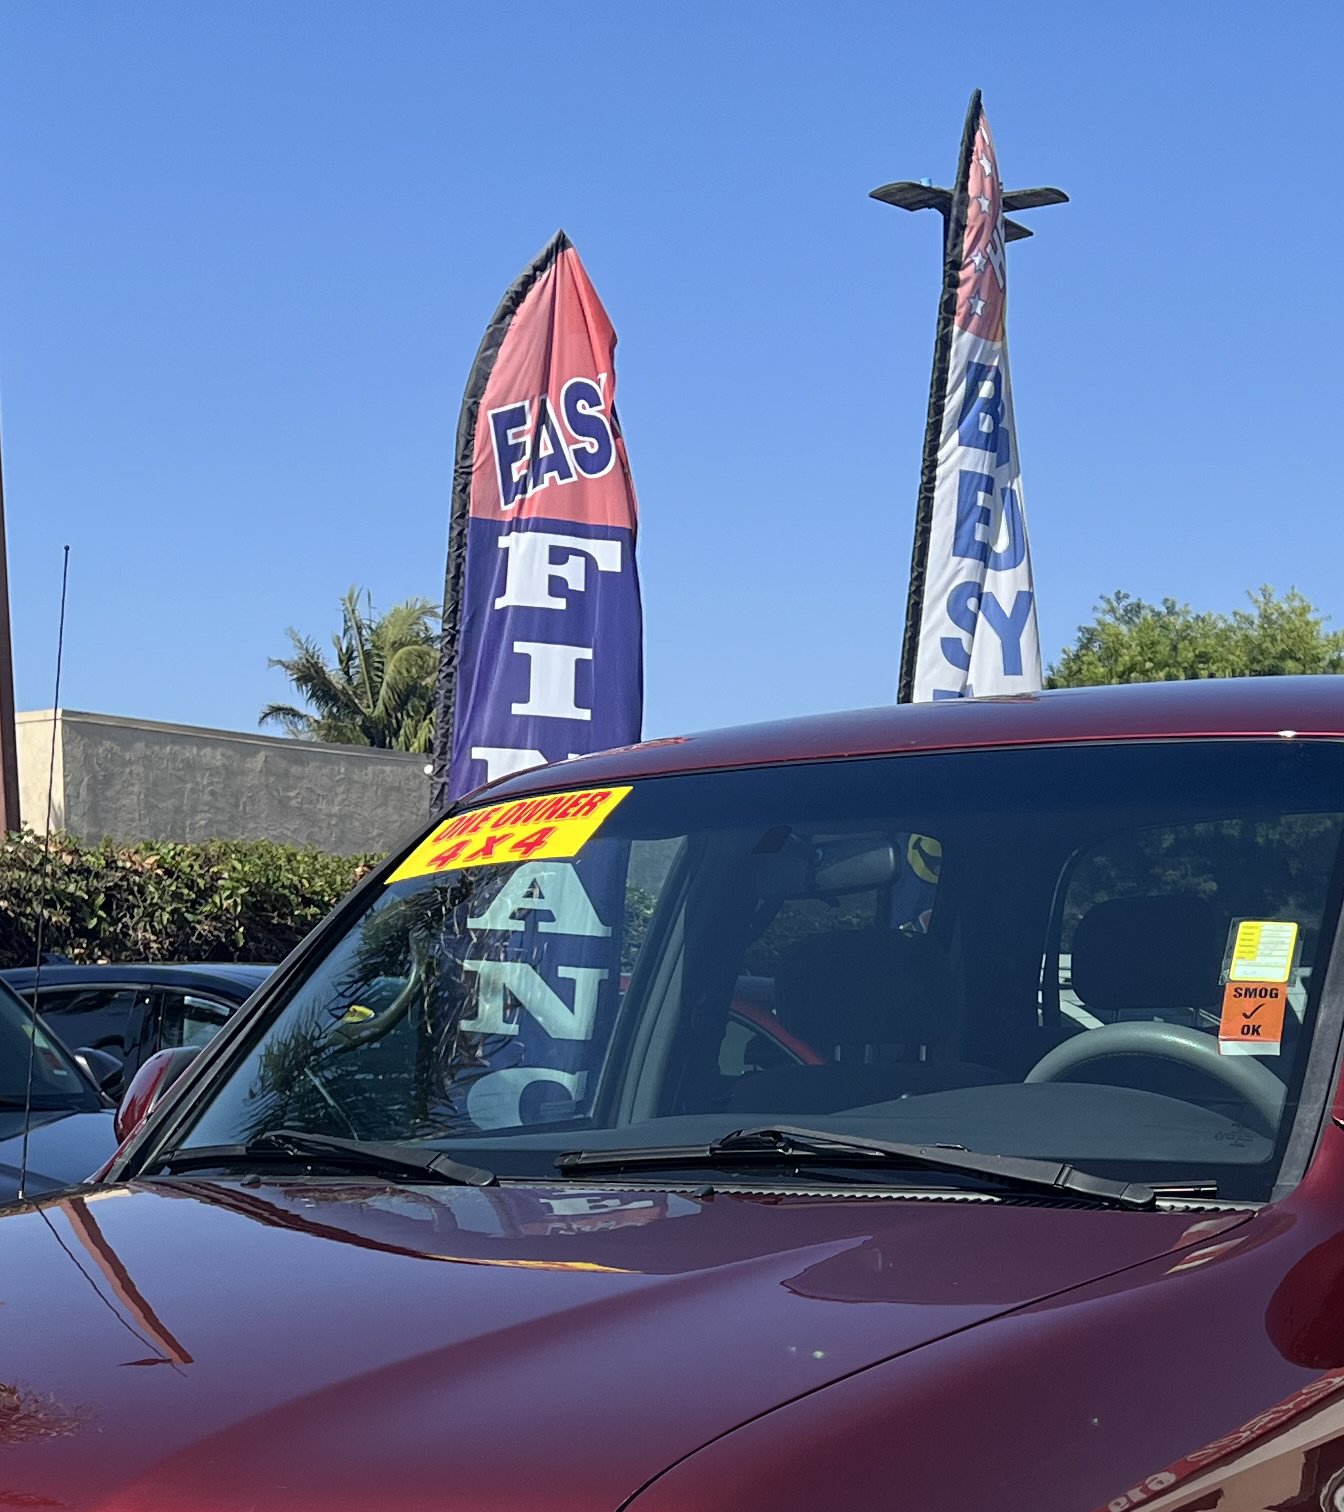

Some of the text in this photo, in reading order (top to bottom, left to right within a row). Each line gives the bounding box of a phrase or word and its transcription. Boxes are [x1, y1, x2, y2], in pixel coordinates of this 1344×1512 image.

[487, 372, 616, 511] EAS
[432, 790, 613, 846] ONE OWNER
[1232, 987, 1279, 999] SMOG
[1240, 1024, 1262, 1036] OK
